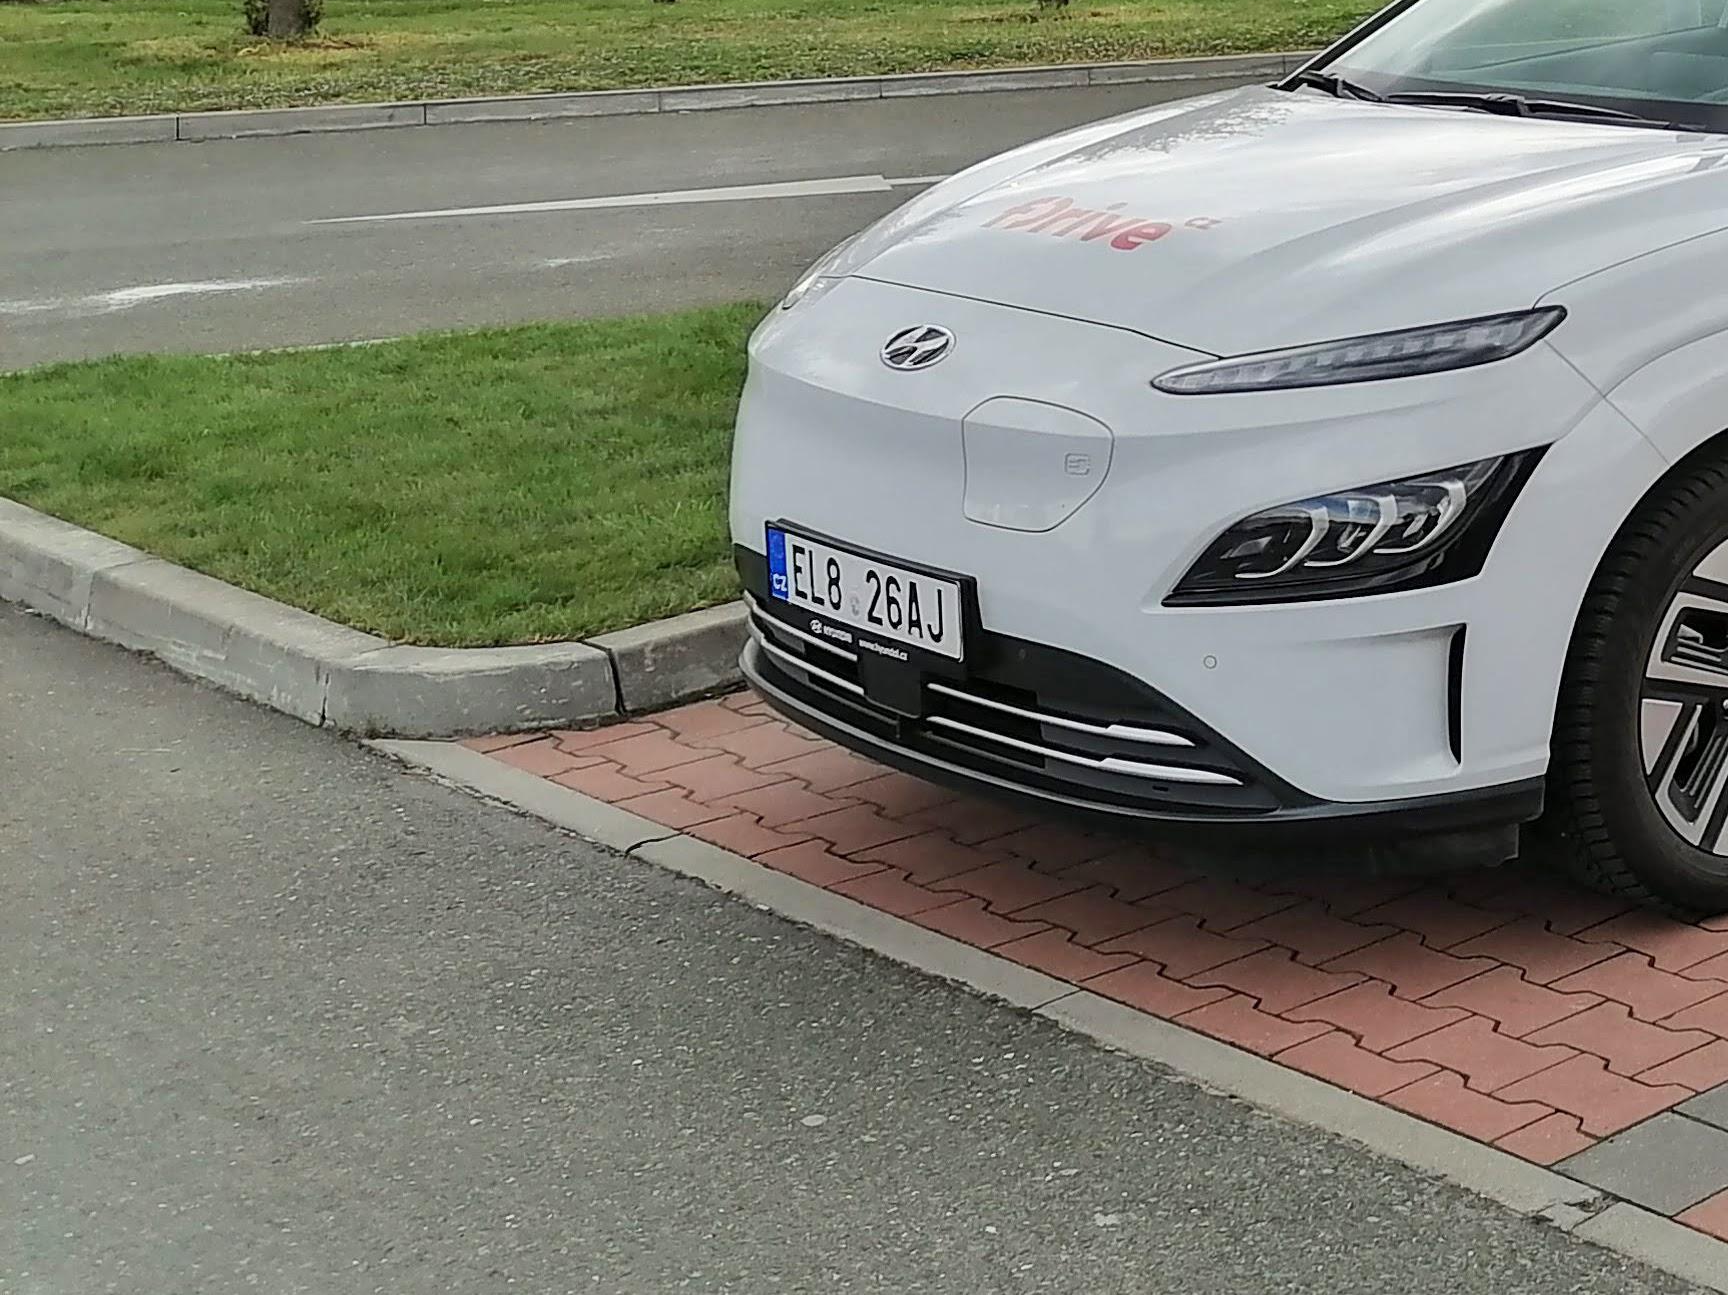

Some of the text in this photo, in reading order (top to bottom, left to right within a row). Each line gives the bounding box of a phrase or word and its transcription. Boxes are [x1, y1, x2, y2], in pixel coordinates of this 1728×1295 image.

[772, 544, 944, 643] CZ EL8 26AJ
